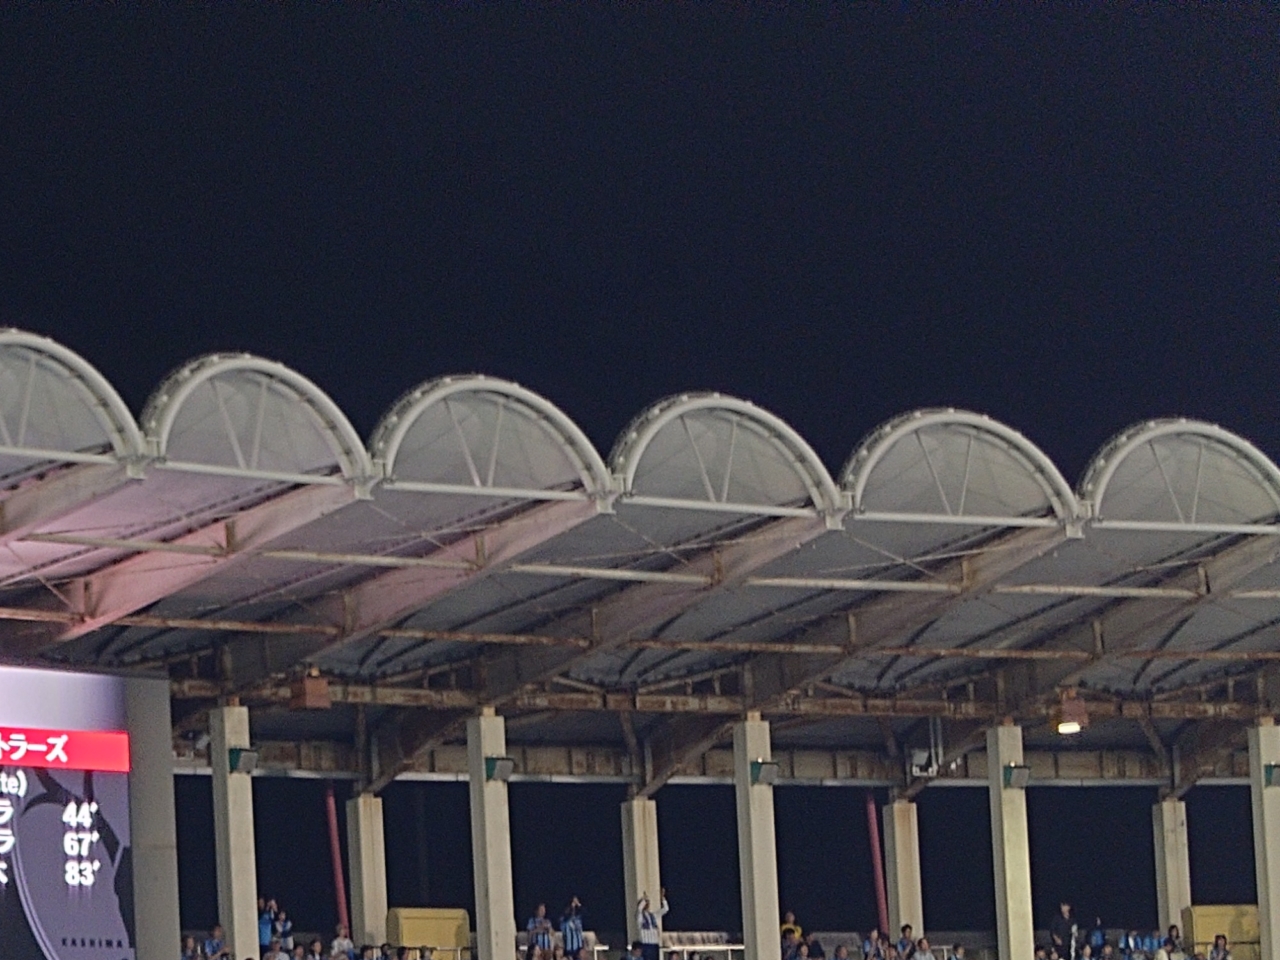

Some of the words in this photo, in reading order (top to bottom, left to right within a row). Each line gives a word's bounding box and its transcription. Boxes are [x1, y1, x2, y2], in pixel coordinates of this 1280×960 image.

[62, 802, 98, 827] 44'
[63, 834, 99, 858] 67'
[64, 861, 101, 887] 83'
